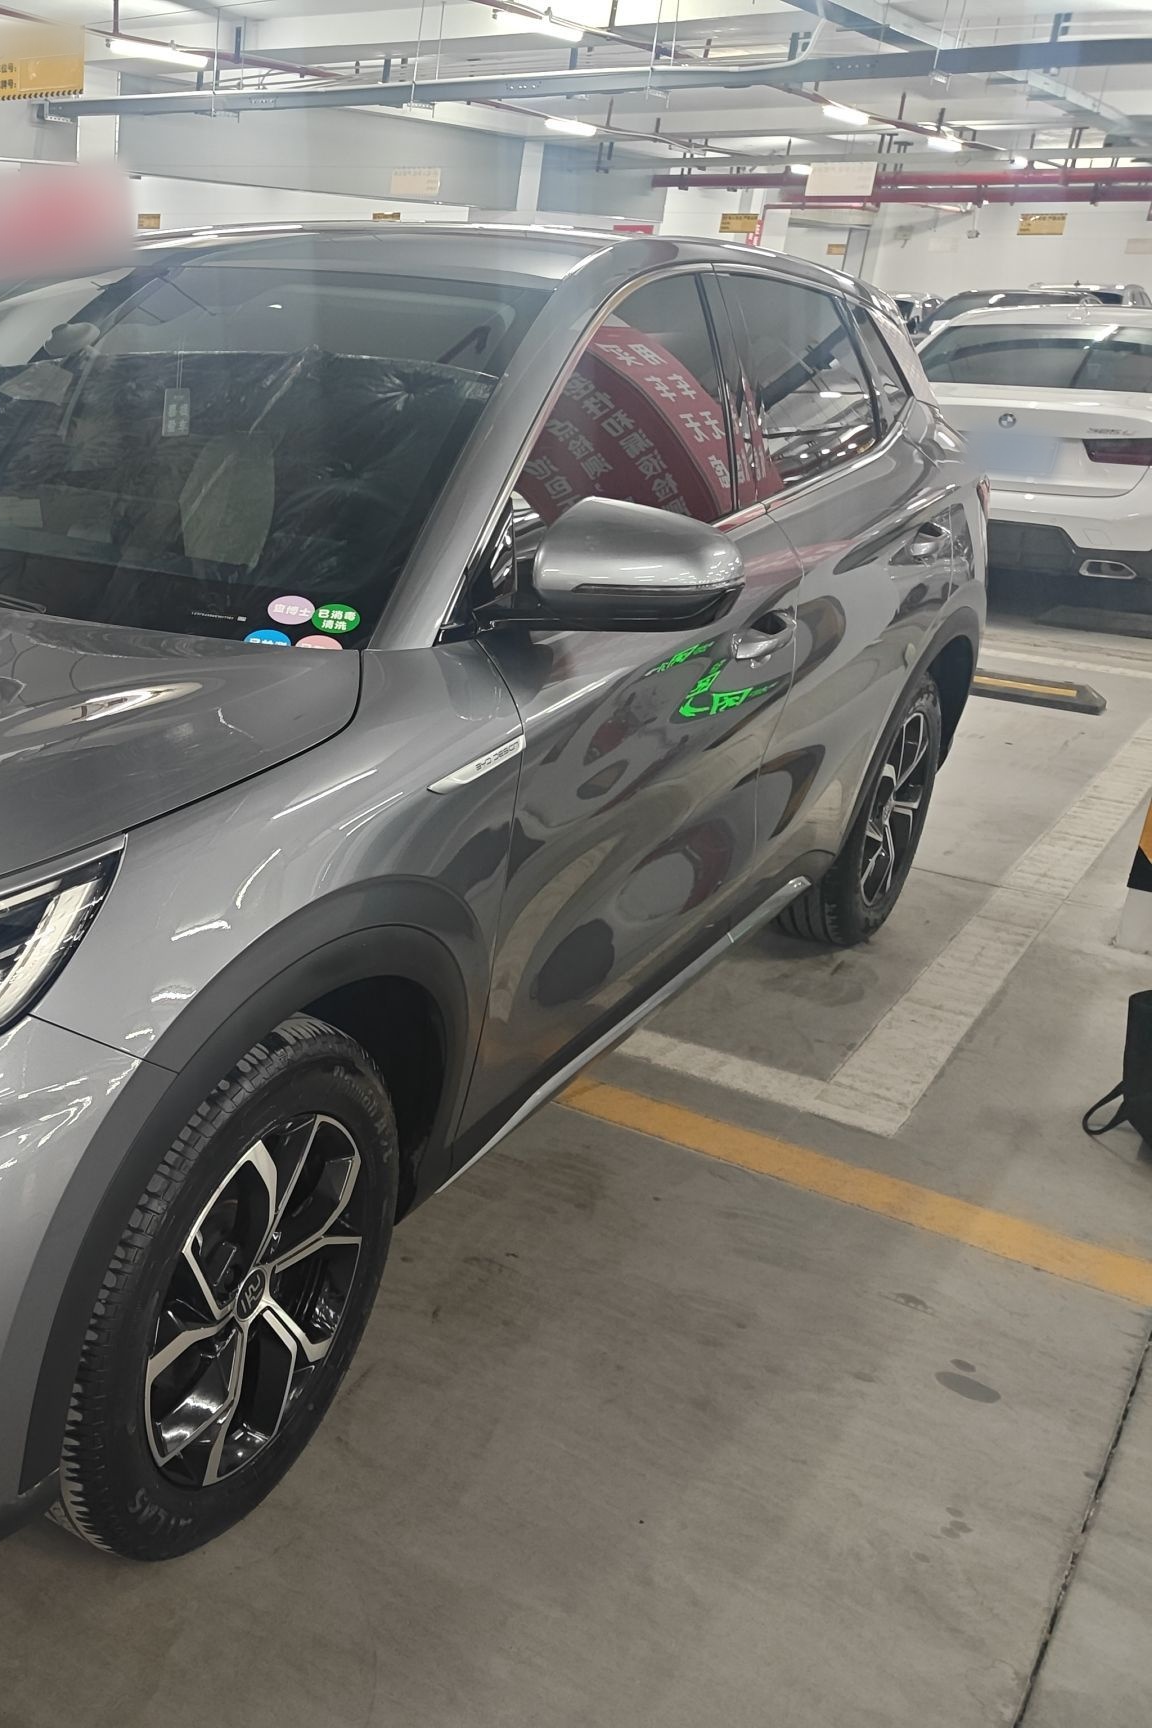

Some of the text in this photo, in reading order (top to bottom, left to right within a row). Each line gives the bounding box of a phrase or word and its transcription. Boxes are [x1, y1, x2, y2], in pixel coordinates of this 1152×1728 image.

[318, 609, 356, 621] 已消毒
[321, 620, 347, 631] 清洗
